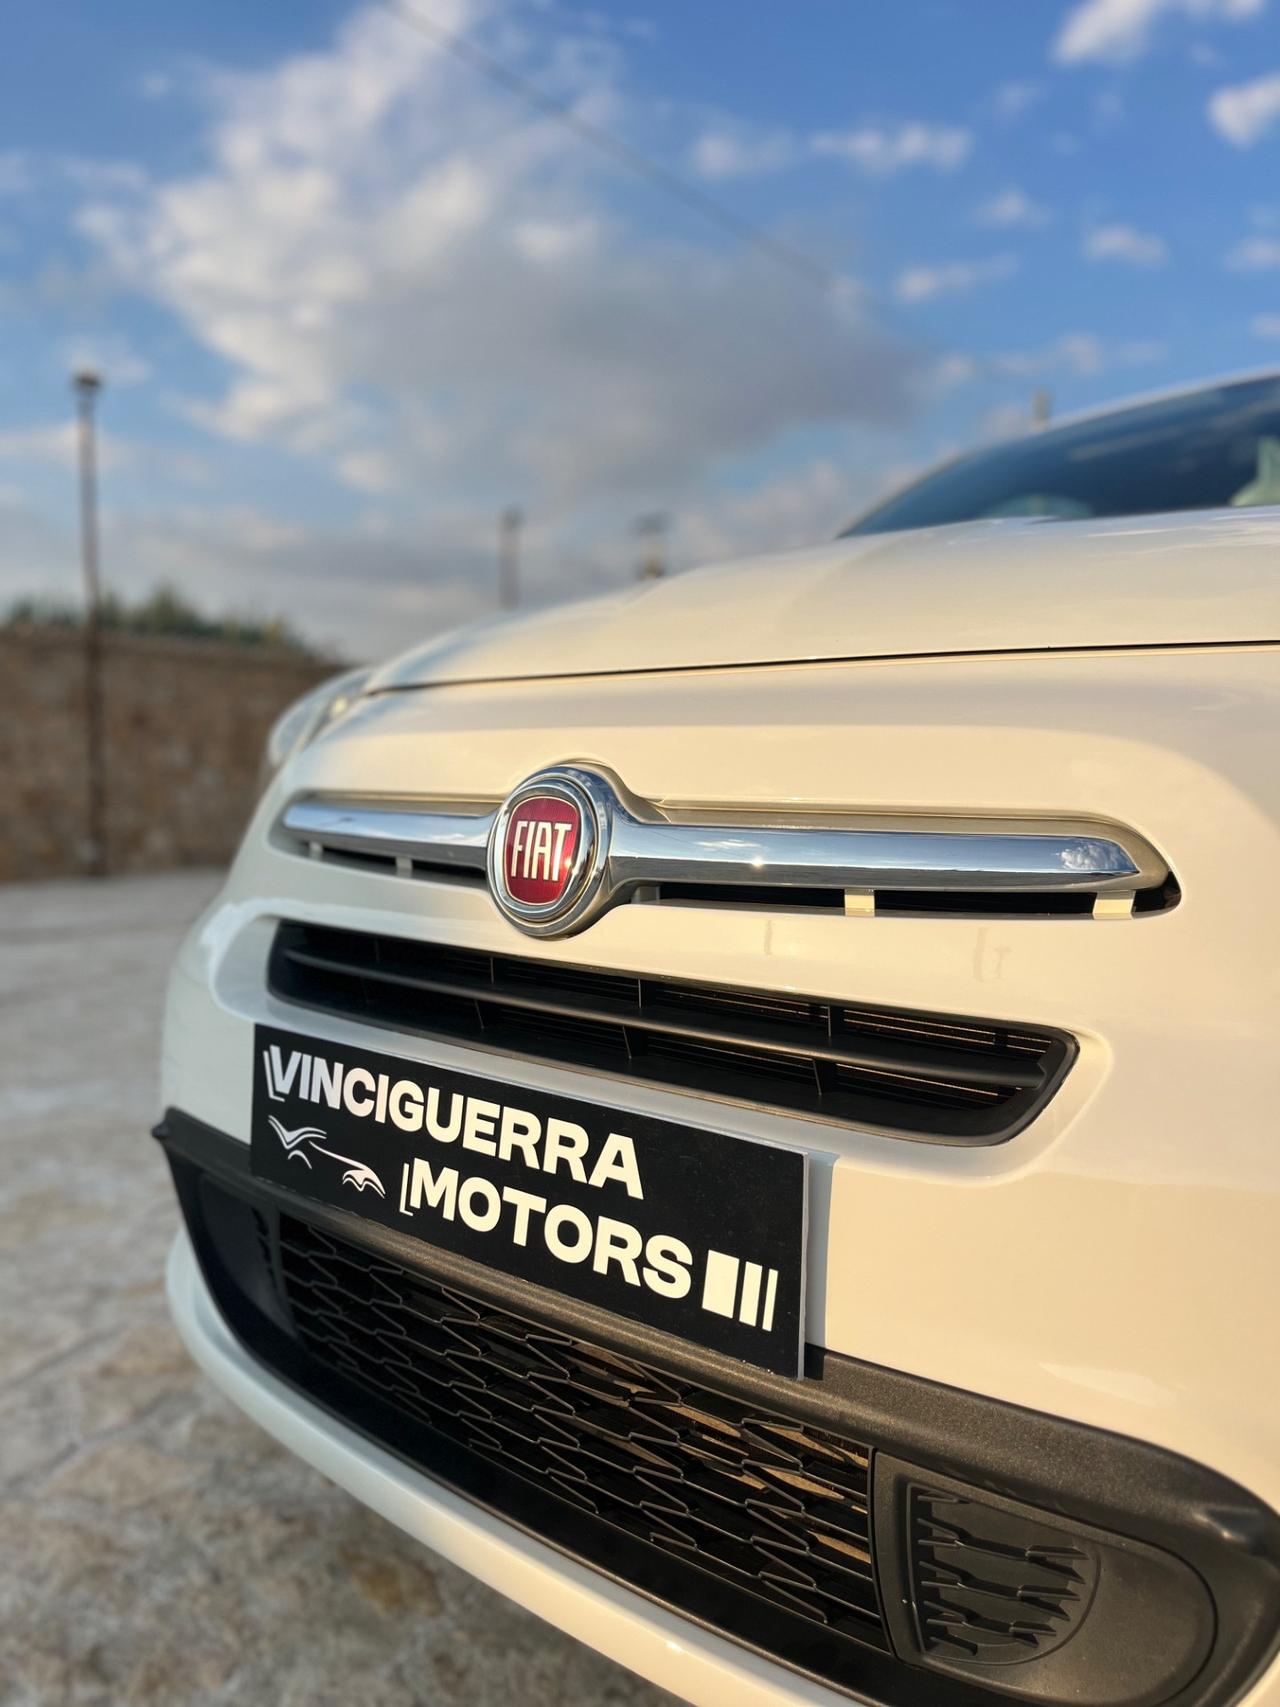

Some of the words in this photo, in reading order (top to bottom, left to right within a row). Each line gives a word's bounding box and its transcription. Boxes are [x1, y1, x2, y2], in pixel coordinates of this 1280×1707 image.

[511, 820, 572, 881] FIAT
[269, 1044, 644, 1199] VINCIGUERRA
[409, 1157, 692, 1299] MOTORS
